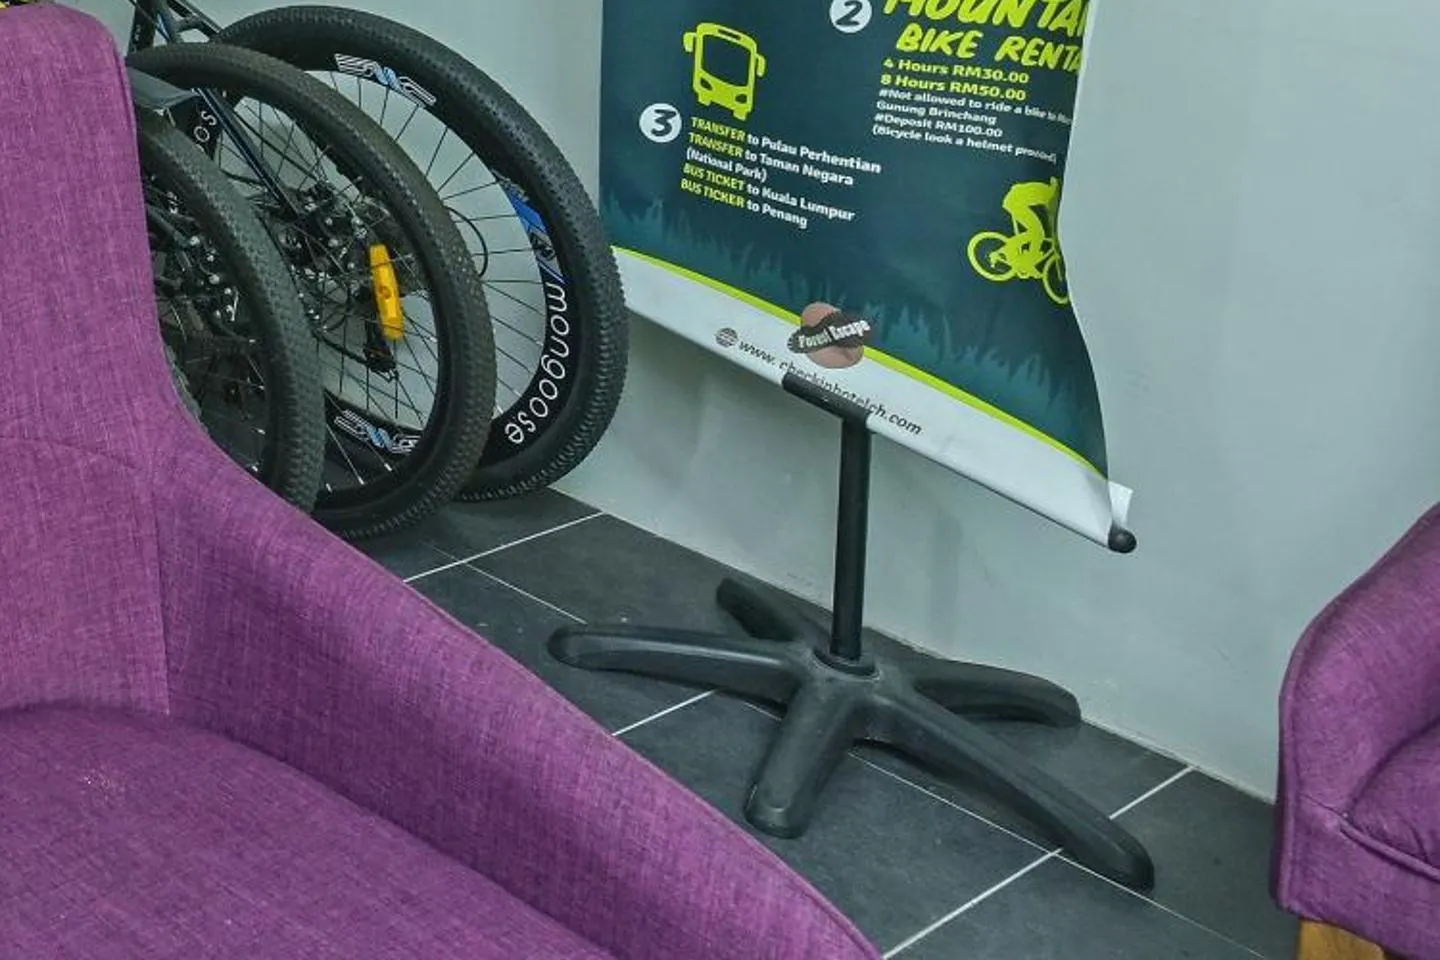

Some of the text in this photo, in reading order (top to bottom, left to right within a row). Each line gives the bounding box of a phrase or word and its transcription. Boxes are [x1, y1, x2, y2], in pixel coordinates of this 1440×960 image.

[896, 23, 1084, 74] BIKE RENTA
[898, 58, 1030, 85] Hours RM30.00
[895, 75, 1027, 102] Hours RM50.00
[914, 92, 1012, 113] allowed ride
[876, 100, 998, 126] Gunung Brinchang
[935, 120, 1003, 138] RM100.00
[688, 132, 854, 186] TRANSFER to Taman Negara
[690, 117, 882, 174] TRANSFER to Pulau Perhentian
[966, 137, 1013, 153] helmet
[686, 147, 768, 184] (National Park)
[681, 178, 808, 229] BUS to Penang
[683, 162, 855, 222] BUS TICKET to Kuala Lumpur
[798, 319, 871, 349] Forest Escape
[505, 279, 570, 446] mongoose
